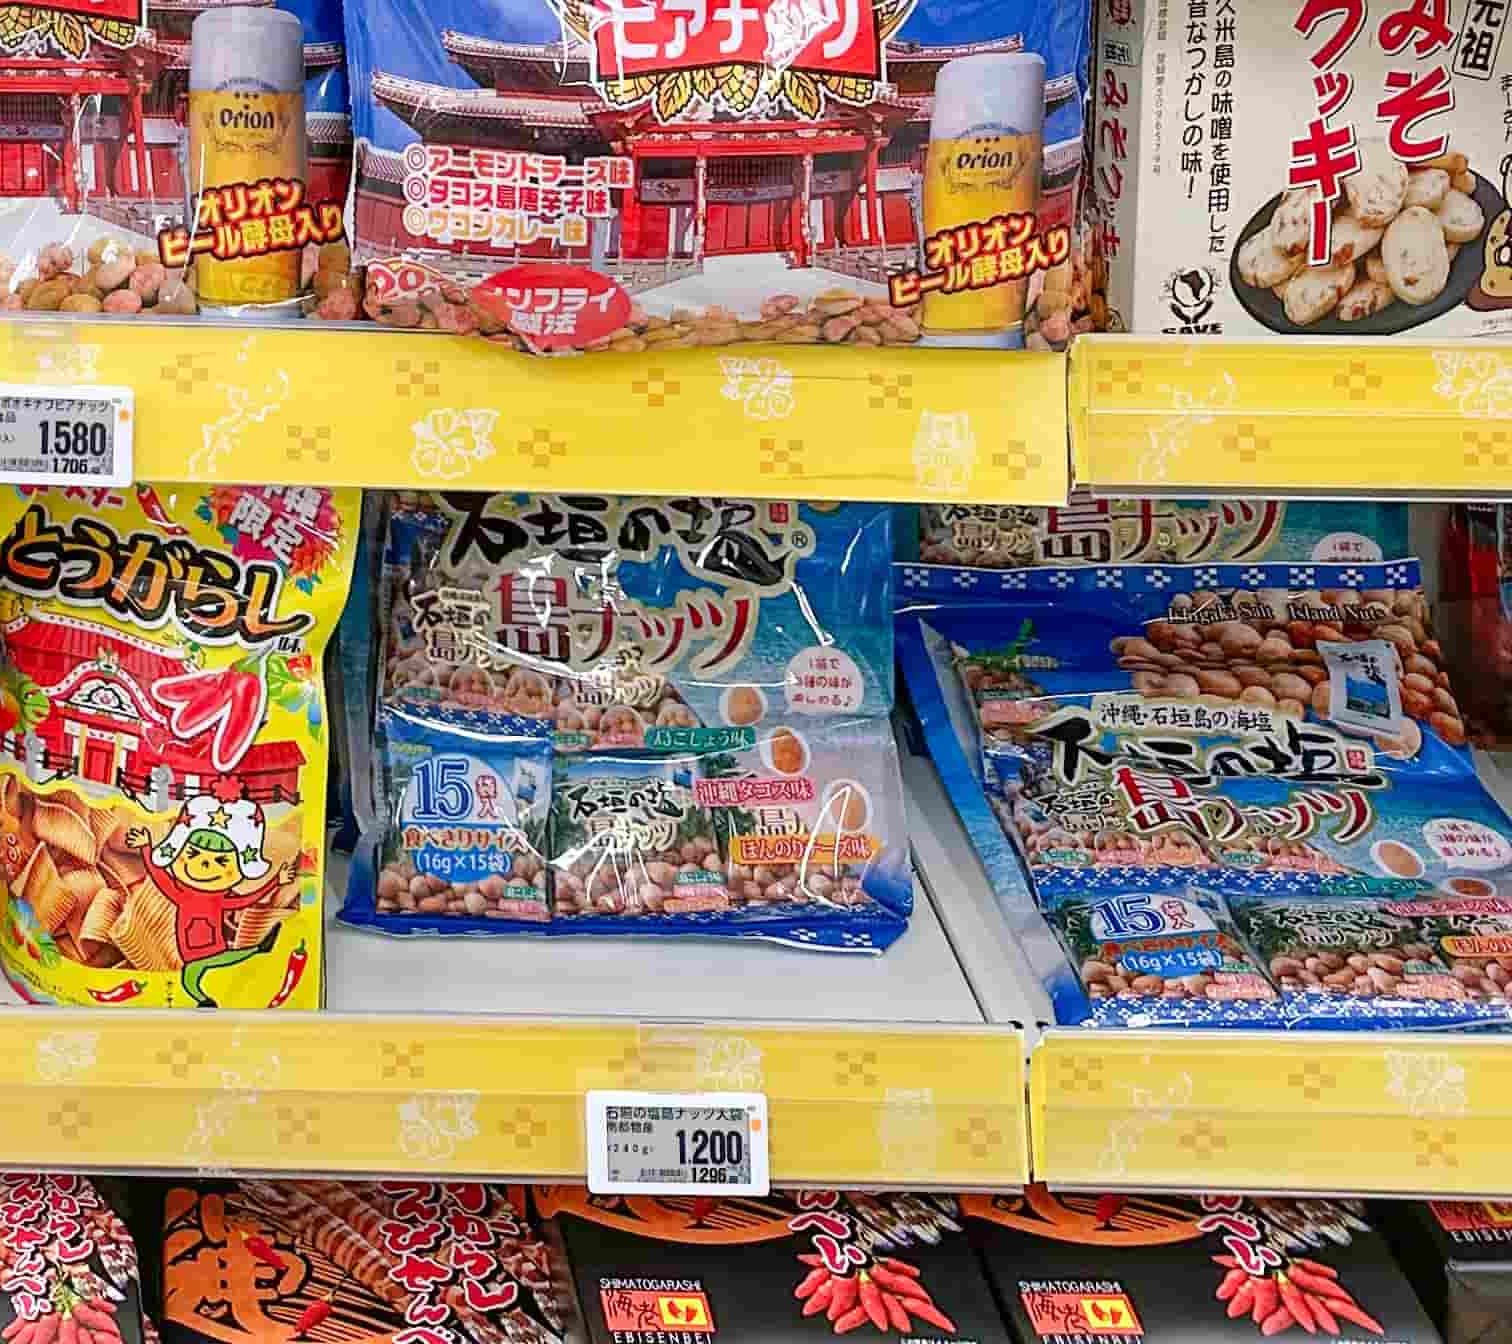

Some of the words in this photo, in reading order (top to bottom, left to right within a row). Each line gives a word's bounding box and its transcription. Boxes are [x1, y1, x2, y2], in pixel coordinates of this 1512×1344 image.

[218, 104, 276, 132] Orion
[954, 147, 1015, 172] Orion
[197, 178, 303, 221] オリオン
[926, 213, 1035, 263] オリオン
[413, 757, 472, 821] 15
[1096, 894, 1162, 937] 15
[598, 1277, 703, 1293] SHIMATOGARASHI
[1017, 1280, 1122, 1294] SHIMATOGARASHI
